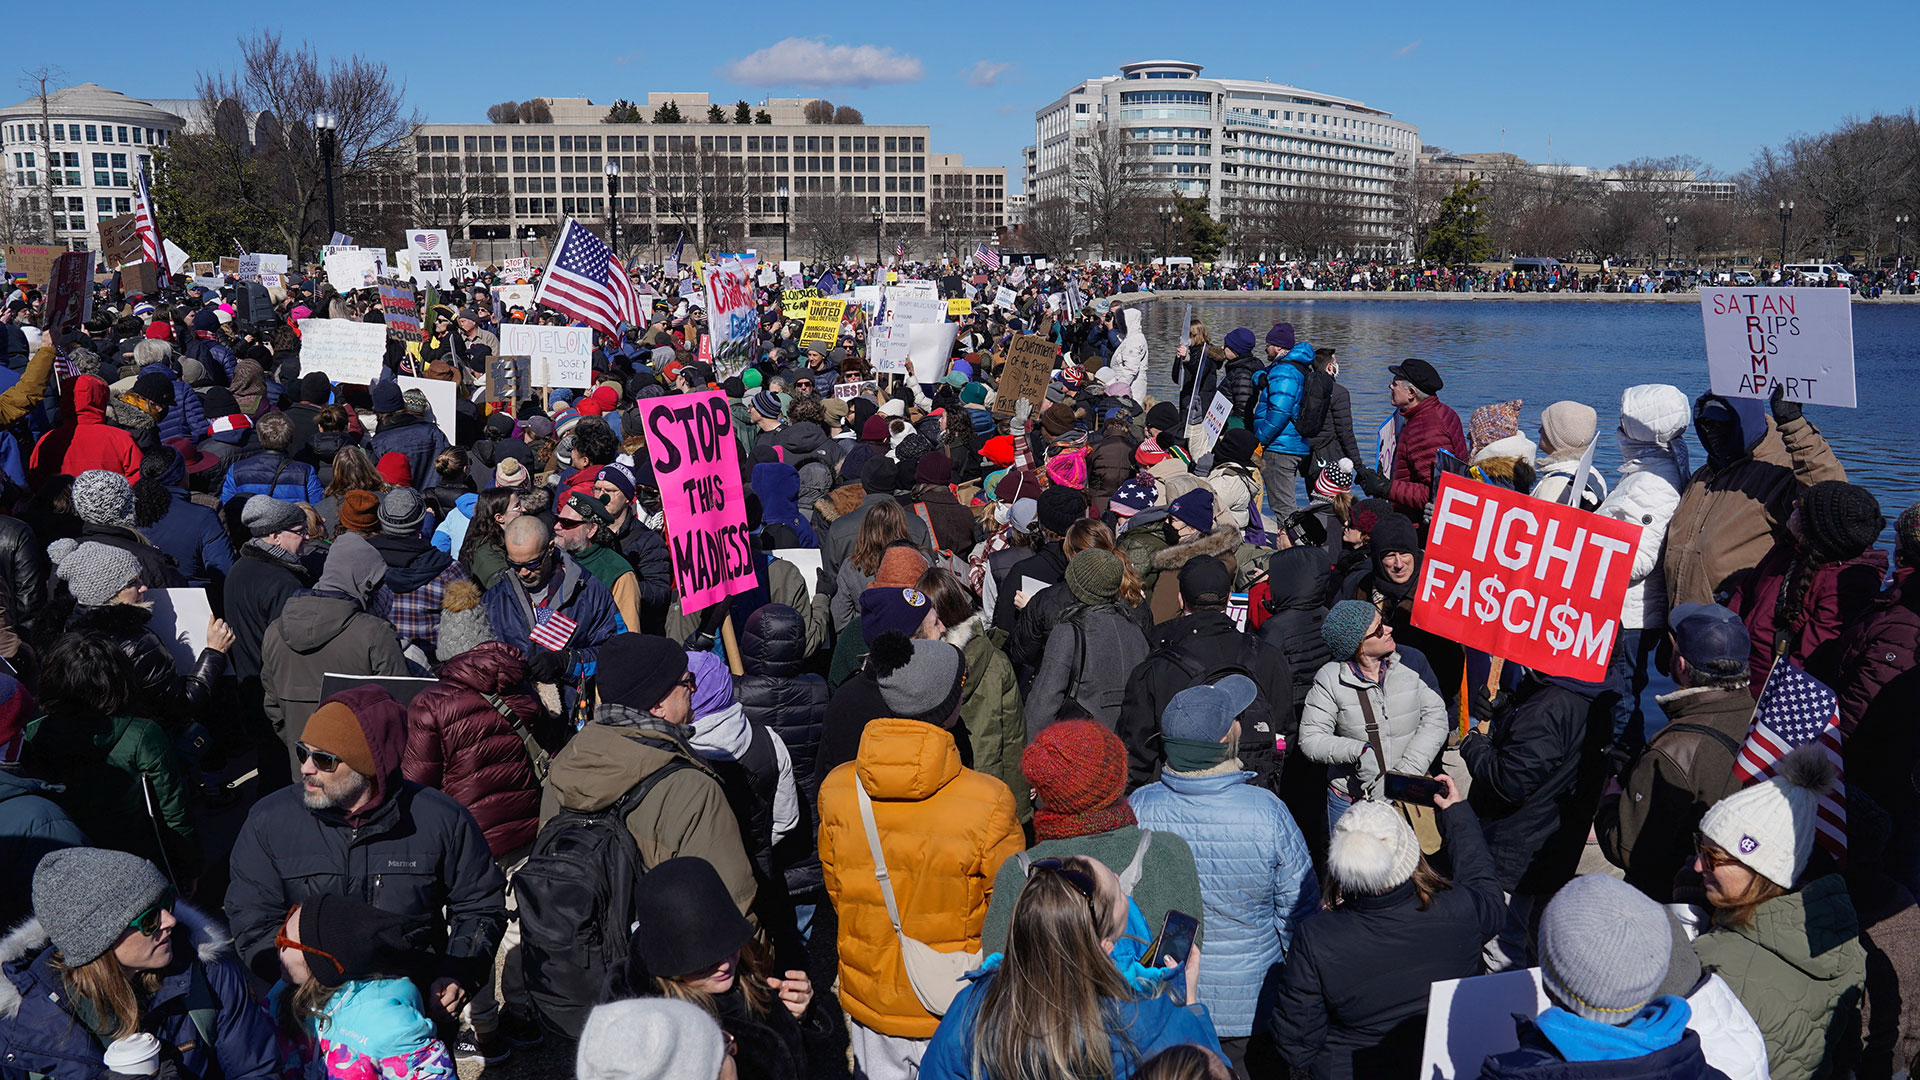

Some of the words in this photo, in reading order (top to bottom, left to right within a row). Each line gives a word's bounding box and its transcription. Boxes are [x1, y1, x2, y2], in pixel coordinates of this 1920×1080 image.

[103, 226, 113, 237] OF
[106, 236, 115, 248] BY
[8, 245, 16, 255] A
[18, 246, 49, 255] WOMANS
[505, 259, 522, 268] STOP
[378, 277, 412, 289] super
[381, 294, 417, 309] fragile
[822, 300, 842, 308] PEOPLE
[1713, 293, 1795, 315] SATAN
[384, 305, 420, 319] racist
[810, 306, 841, 318] UNITED
[820, 315, 839, 323] DEFEND
[1746, 315, 1801, 336] RIPS
[391, 321, 418, 333] nazi
[806, 325, 837, 334] IMMIGRANT
[387, 327, 423, 342] potus
[803, 332, 835, 342] FAMILIES!
[1015, 337, 1055, 359] Government
[1747, 334, 1778, 355] US
[558, 359, 588, 369] DOGEY
[879, 357, 896, 370] KIDS
[561, 371, 585, 381] STYLE
[1023, 372, 1031, 386] by
[1034, 374, 1043, 386] the
[1738, 374, 1817, 399] APART
[649, 396, 731, 475] STOP
[683, 475, 726, 517] THIS
[1431, 486, 1630, 600] FIGHT
[672, 522, 752, 598] MADNESS
[1420, 558, 1615, 667] FA$CI$M
[388, 860, 417, 868] Marmot
